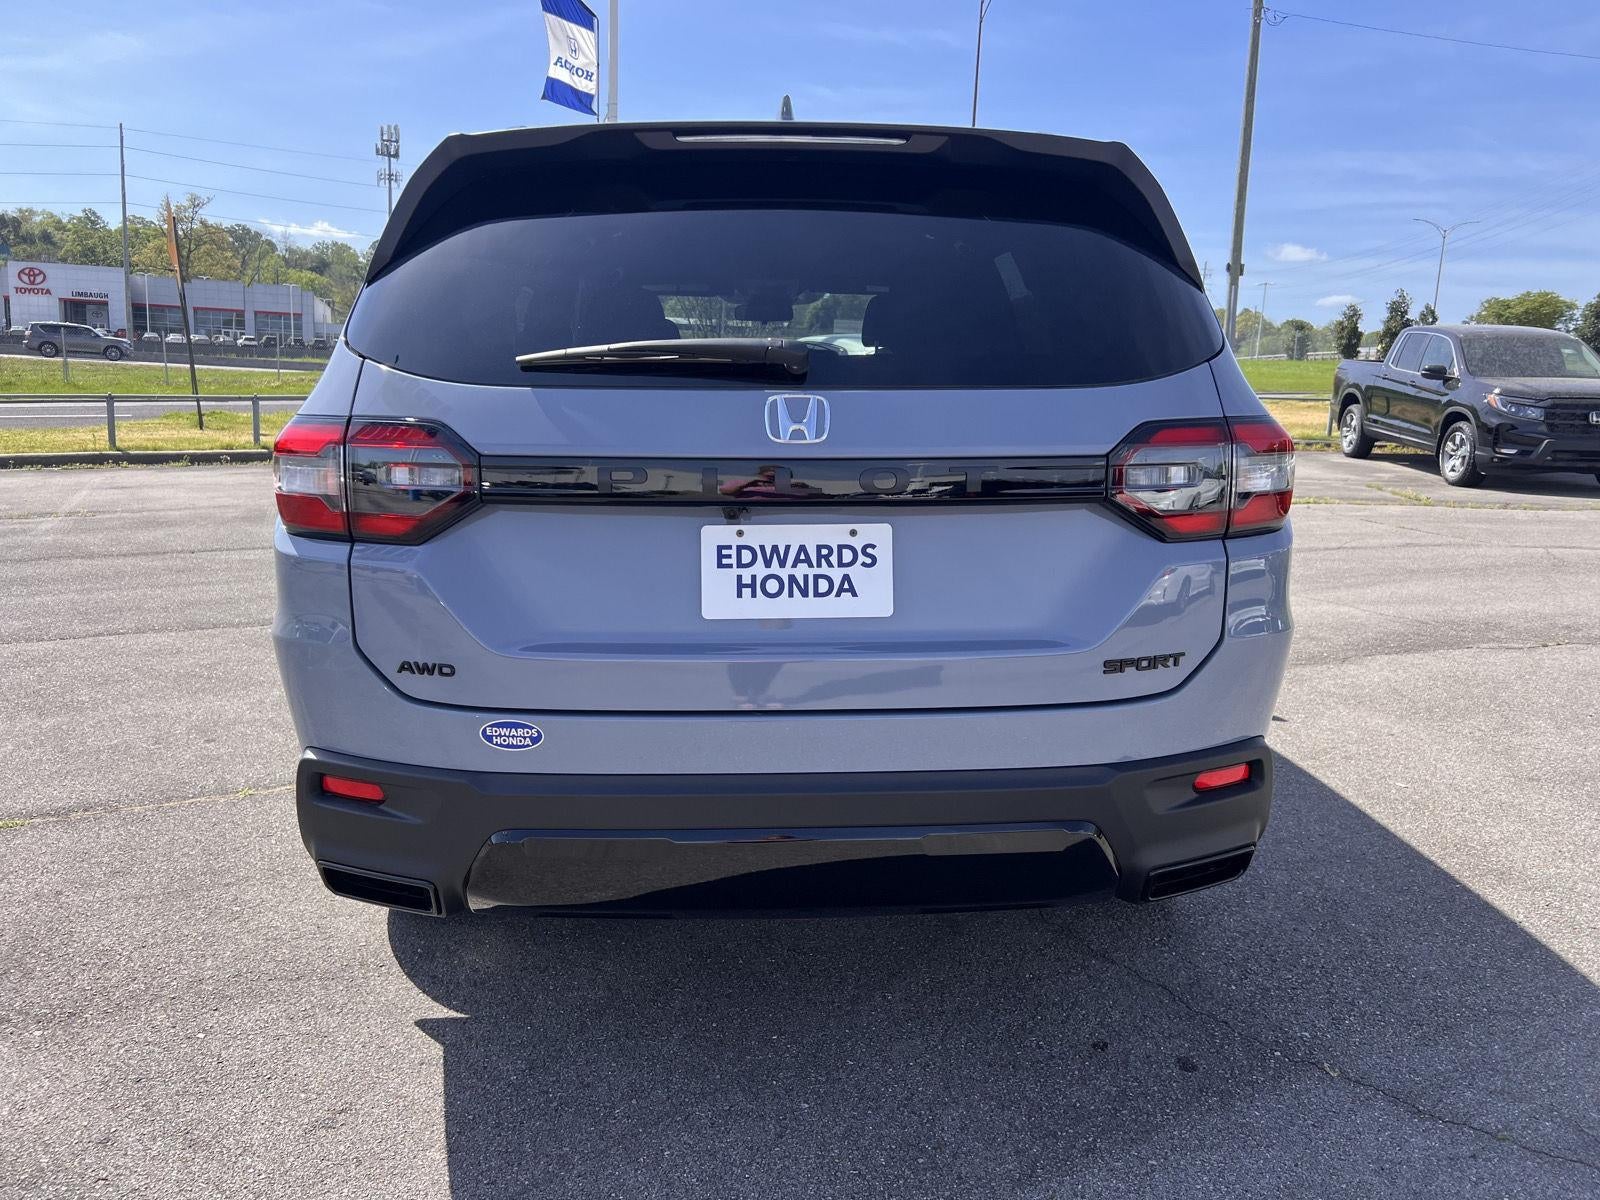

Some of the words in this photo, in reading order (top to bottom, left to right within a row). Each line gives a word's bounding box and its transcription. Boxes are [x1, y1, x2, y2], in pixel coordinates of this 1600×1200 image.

[13, 286, 52, 296] TOYOTA
[71, 290, 109, 299] LIMBAUGH
[597, 466, 1001, 495] PILOT
[716, 543, 878, 569] EDWARDS
[736, 573, 859, 599] HONDA
[396, 660, 456, 678] AWD
[1102, 651, 1186, 675] SPORT
[486, 727, 538, 738] EDWARDS
[492, 736, 532, 746] HONDA
